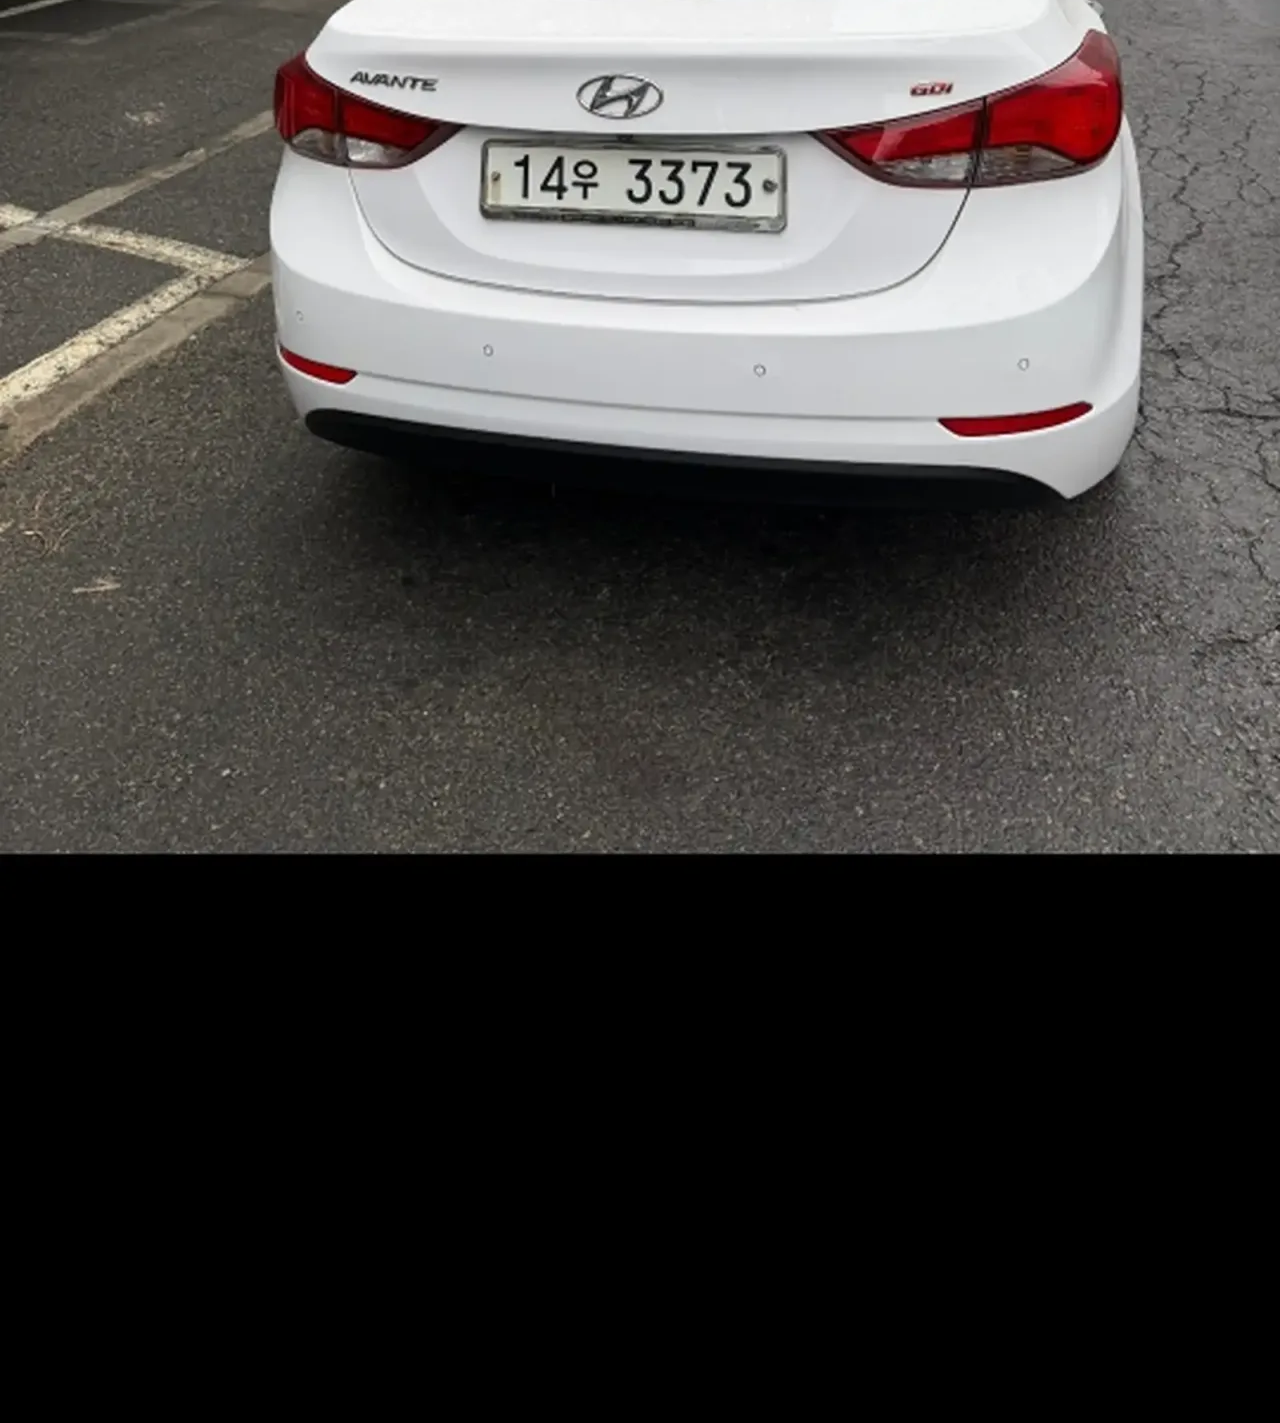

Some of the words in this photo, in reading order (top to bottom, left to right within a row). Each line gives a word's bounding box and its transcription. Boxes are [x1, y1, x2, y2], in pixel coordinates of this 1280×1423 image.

[349, 70, 439, 92] AVANTE
[513, 154, 599, 201] 14우
[626, 158, 752, 208] 3373
